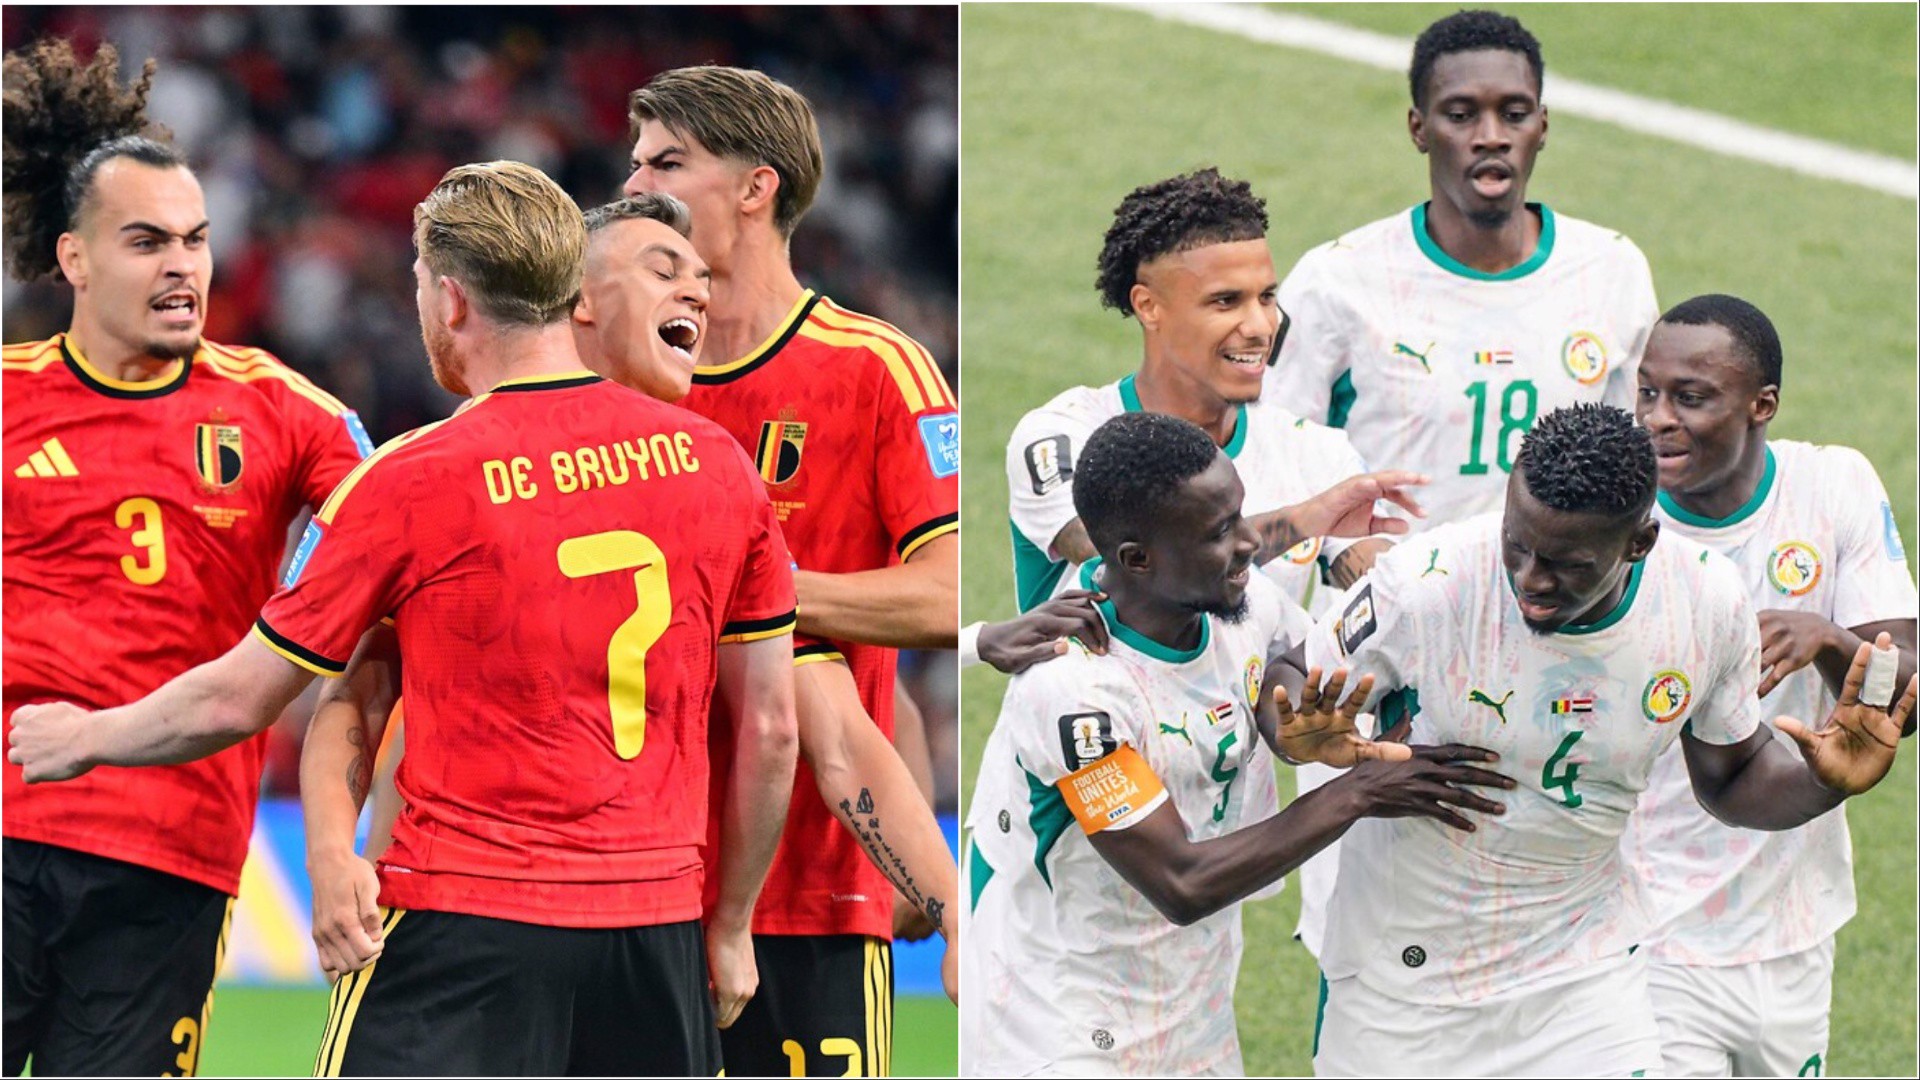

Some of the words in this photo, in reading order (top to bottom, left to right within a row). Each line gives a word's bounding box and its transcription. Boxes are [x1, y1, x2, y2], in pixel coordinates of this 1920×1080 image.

[1459, 379, 1538, 475] 18
[482, 457, 539, 505] DE
[551, 431, 700, 494] BRUYNE
[115, 497, 167, 585] 3
[557, 530, 672, 760] 7
[1072, 760, 1120, 790] FOOTBALL
[1078, 769, 1127, 804] UNITES
[1086, 803, 1105, 818] the
[1103, 781, 1140, 808] World
[1211, 731, 1239, 822] 5
[1542, 731, 1584, 808] 4
[1109, 805, 1129, 818] FIFA
